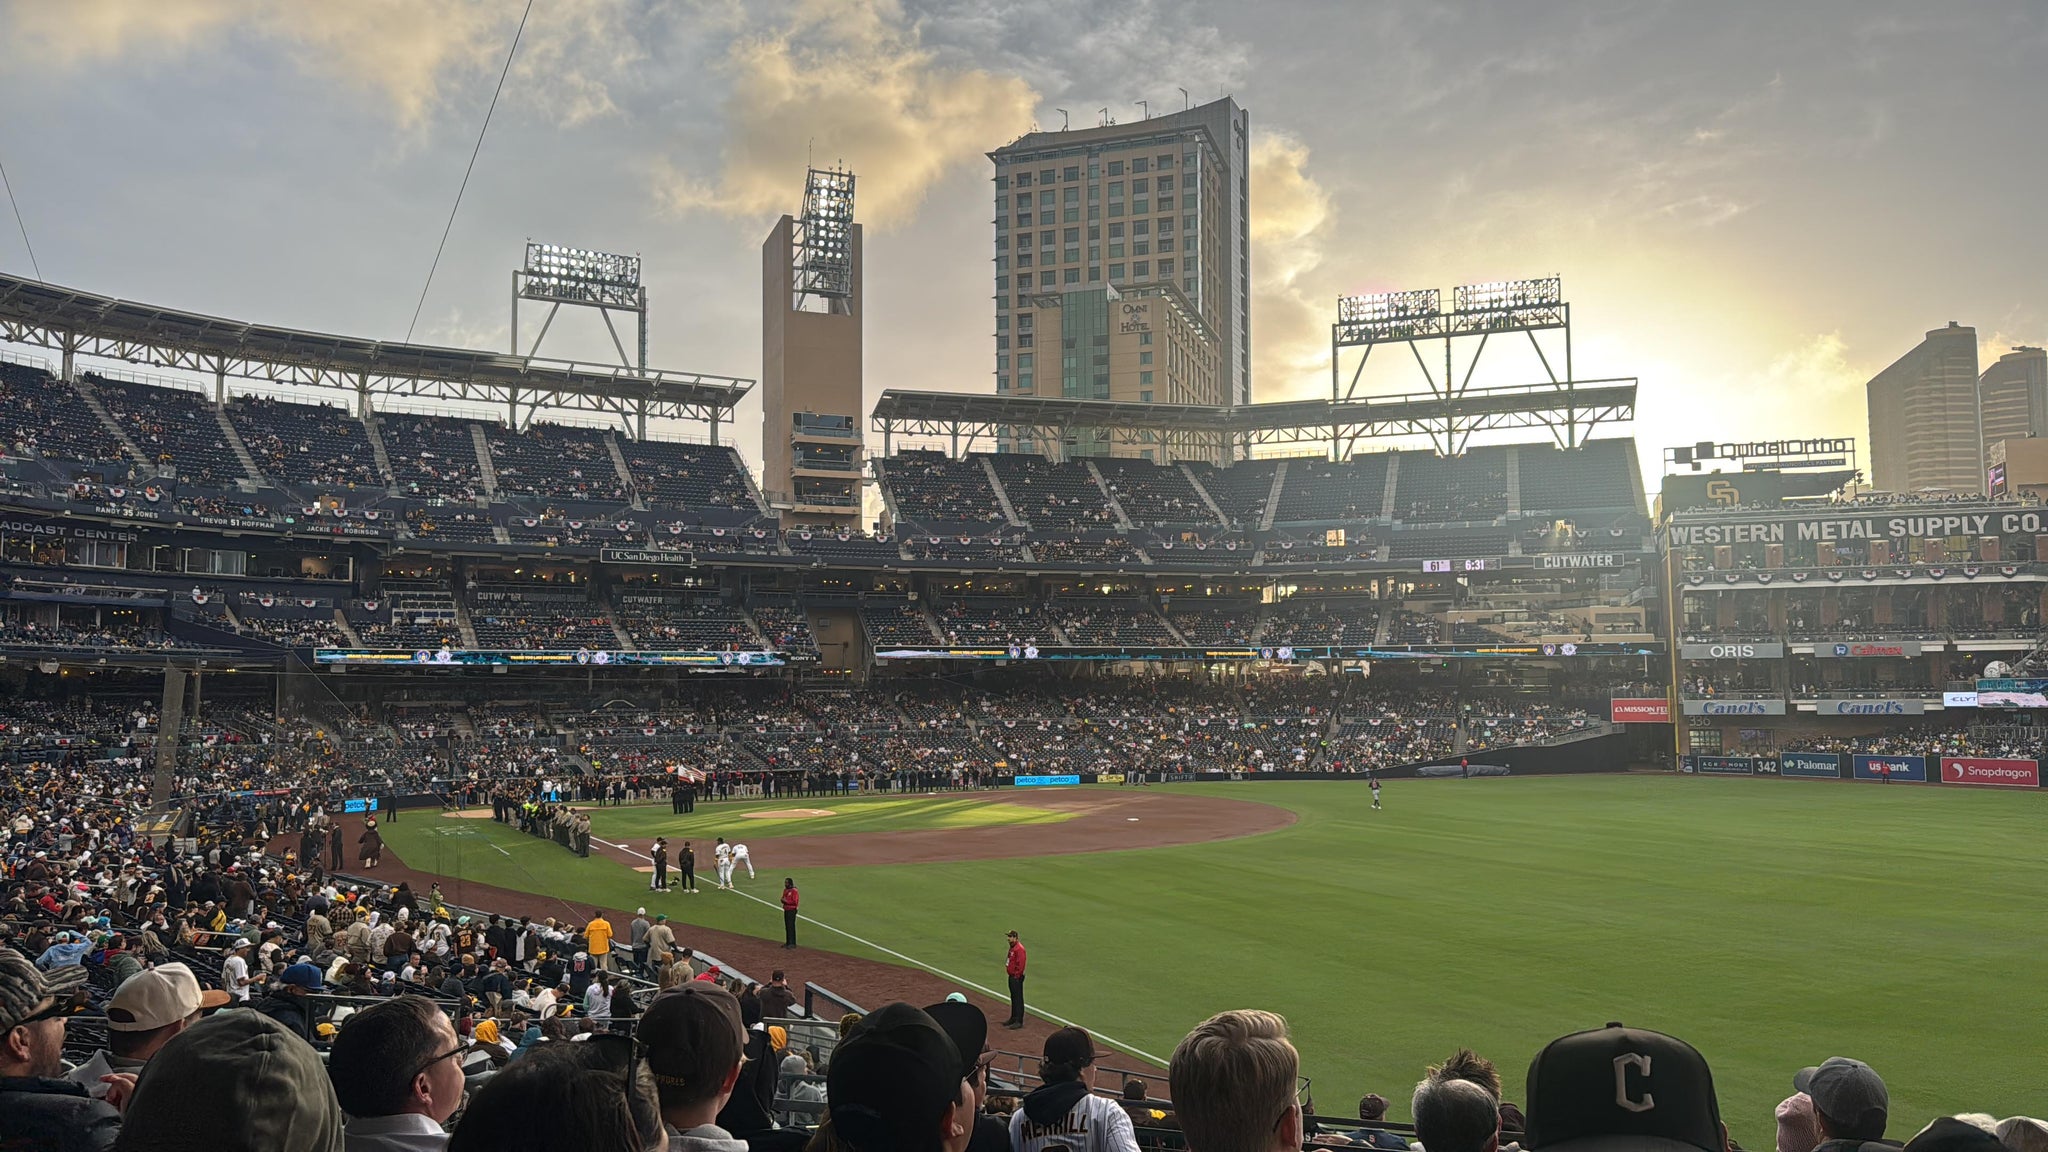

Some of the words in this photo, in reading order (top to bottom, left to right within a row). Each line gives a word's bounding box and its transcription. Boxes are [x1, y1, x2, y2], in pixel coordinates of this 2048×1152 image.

[1123, 304, 1147, 313] OMNI
[1121, 321, 1149, 332] HOTEL
[1721, 438, 1846, 460] QuidelOrtho
[95, 505, 120, 515] RANDY
[123, 508, 133, 517] 35
[135, 510, 159, 519] JONES
[200, 516, 228, 525] TREVOR
[230, 518, 240, 527] 51
[241, 520, 275, 529] HOFFMAN
[74, 528, 138, 542] CENTER
[306, 525, 331, 533] JACKIE
[332, 526, 343, 535] 42
[344, 527, 379, 536] ROBINSON
[1670, 523, 1784, 545] WESTERN
[1798, 519, 1881, 541] METAL
[1888, 515, 1989, 538] SUPPLY
[2002, 513, 2047, 533] CO.
[611, 551, 624, 560] UC
[624, 552, 638, 560] San
[639, 553, 660, 562] Diego
[661, 553, 684, 562] Health
[1543, 553, 1614, 568] CUTWATER
[1465, 559, 1485, 570] 6:31
[622, 595, 664, 604] CUTWATER
[1710, 645, 1754, 657] ORIS
[1852, 644, 1903, 656] Calimax
[1703, 701, 1766, 714] Canel's
[1837, 700, 1903, 715] Canel's
[1757, 761, 1777, 773] 342
[1797, 759, 1838, 771] Palomar
[1869, 762, 1881, 771] us
[1968, 766, 2032, 779] Snapdragon
[460, 934, 471, 947] 23
[1613, 1052, 1655, 1112] C
